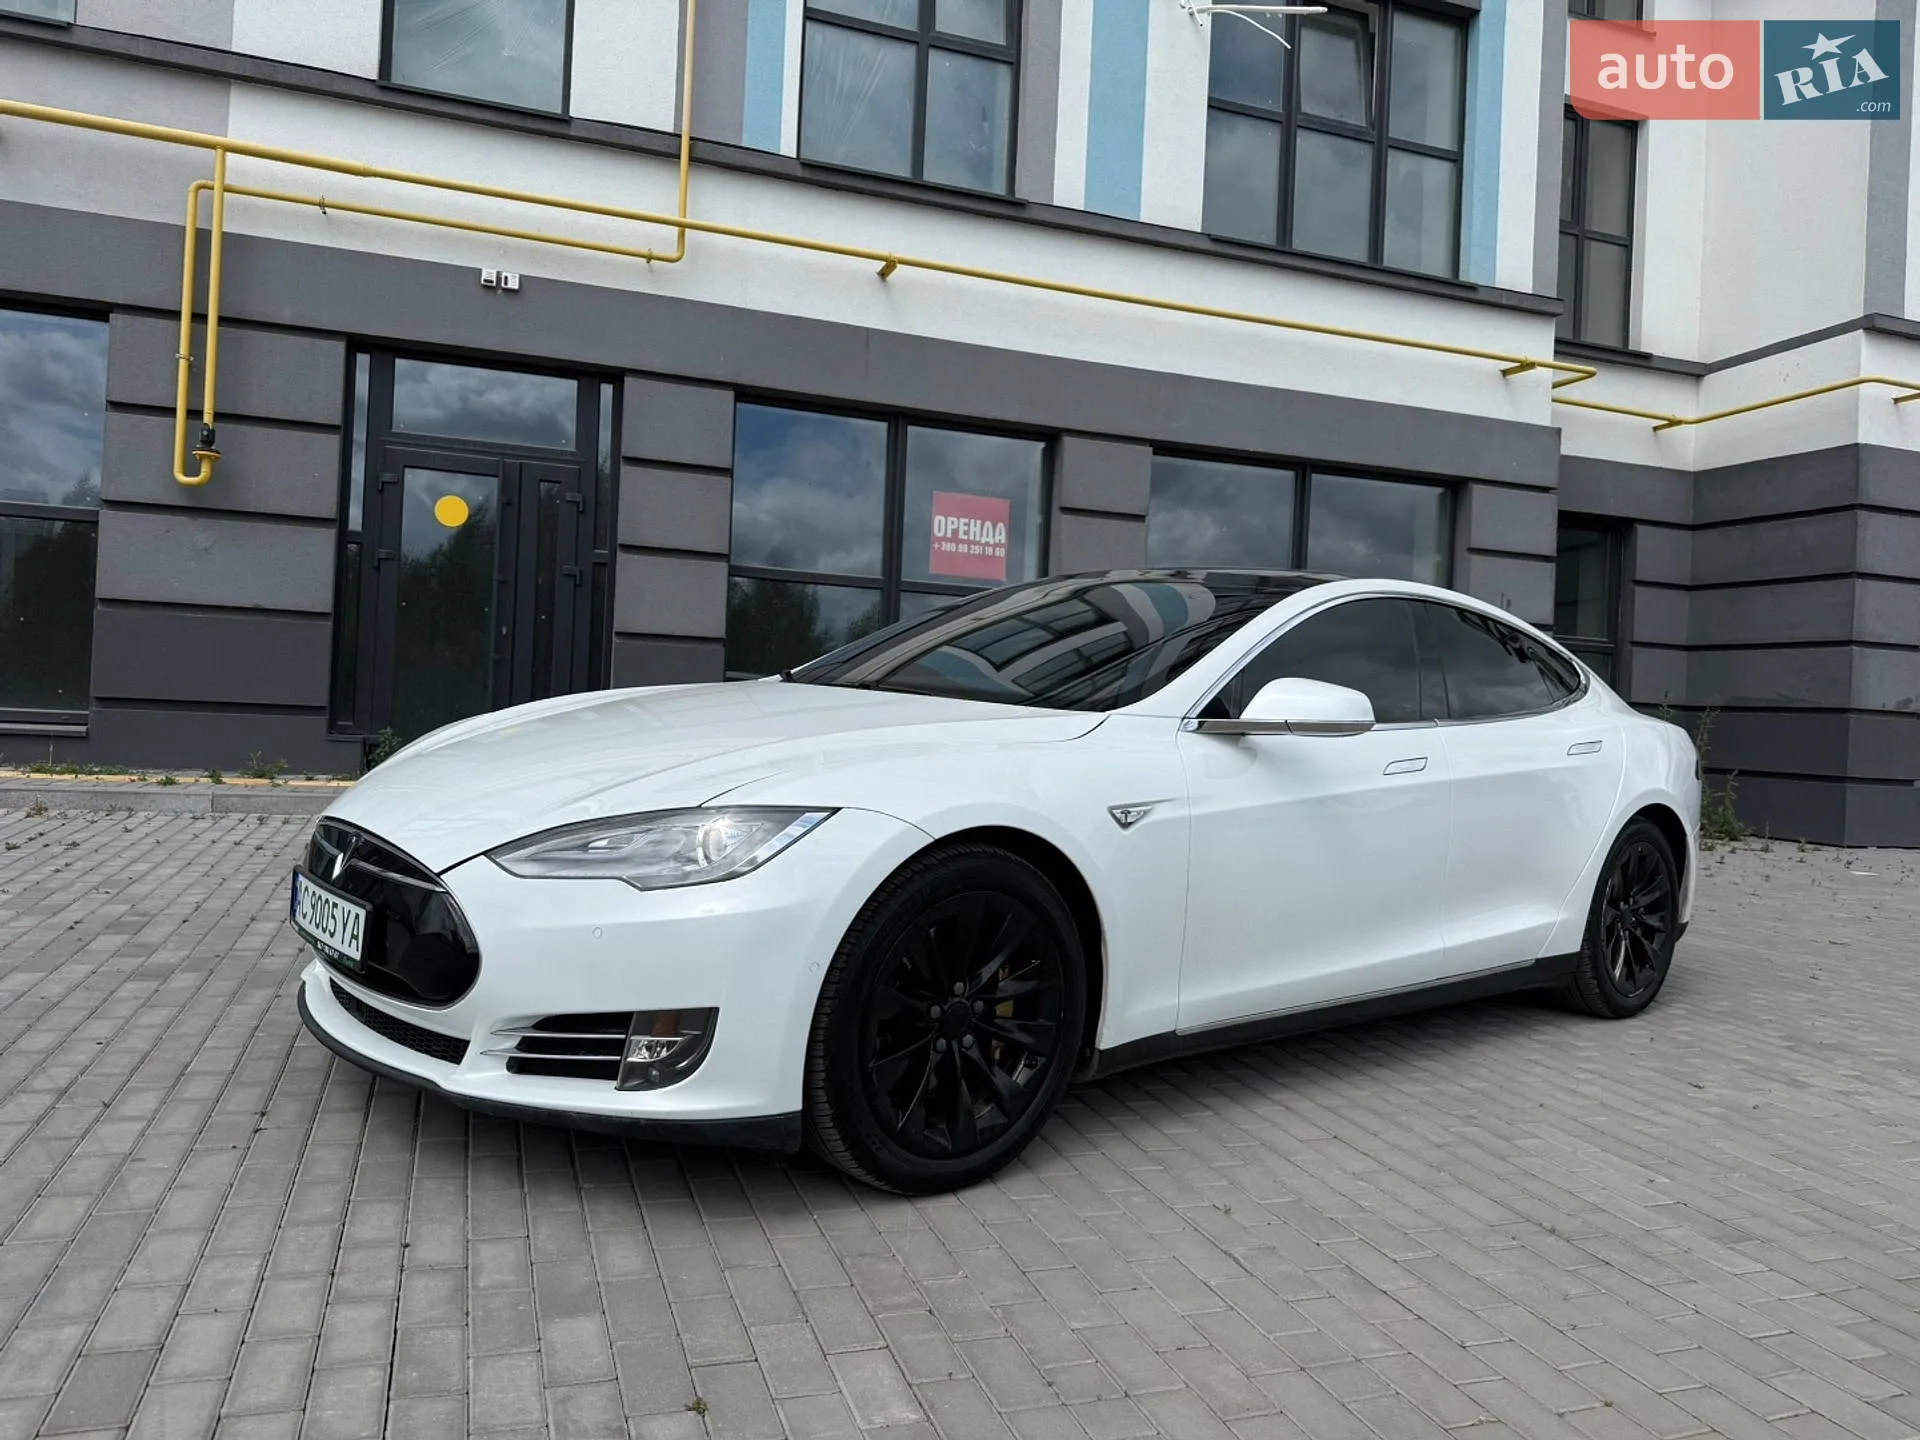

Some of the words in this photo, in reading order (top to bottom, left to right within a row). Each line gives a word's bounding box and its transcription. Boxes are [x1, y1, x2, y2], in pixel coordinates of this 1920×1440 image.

[933, 515, 1006, 545] ОРЕНДА
[309, 890, 339, 939] 9005
[341, 905, 361, 953] YA
